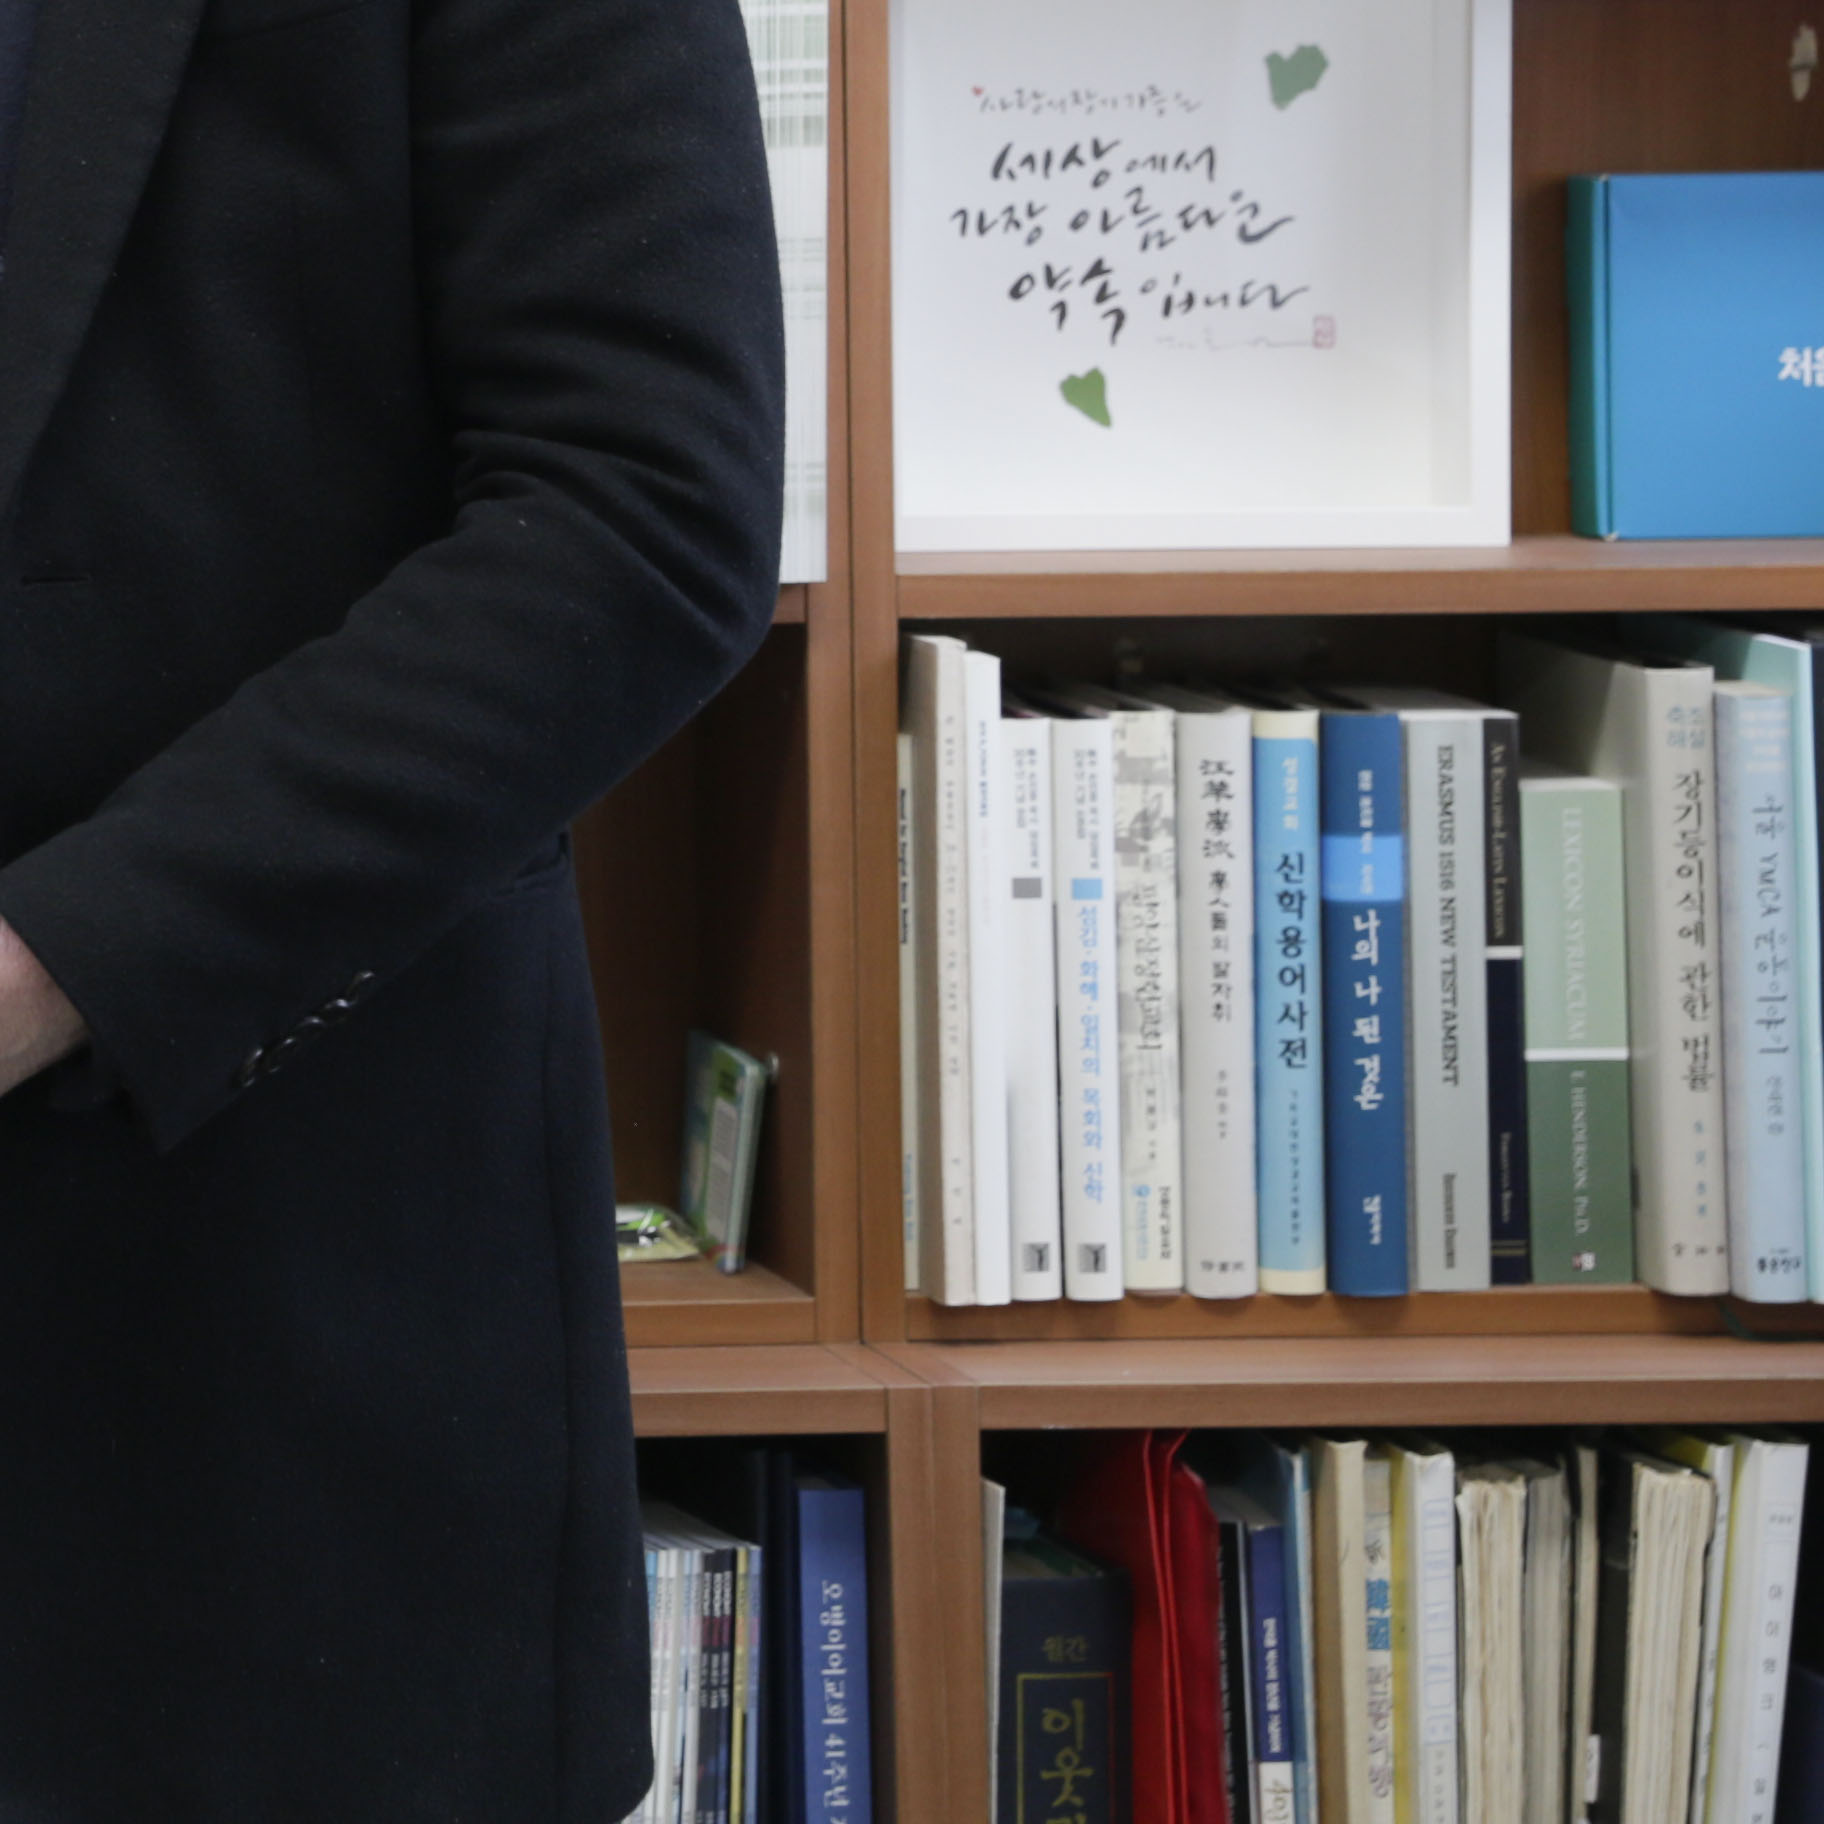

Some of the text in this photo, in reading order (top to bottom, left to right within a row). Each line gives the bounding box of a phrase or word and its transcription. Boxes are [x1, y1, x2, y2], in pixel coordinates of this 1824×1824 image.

[951, 187, 1294, 252] 가장 아름다운
[990, 138, 1218, 189] 세상에서
[1276, 852, 1307, 1070] 신학용어사전
[1438, 745, 1459, 1086] ERASMUS 1516 NEW TESTAMENT
